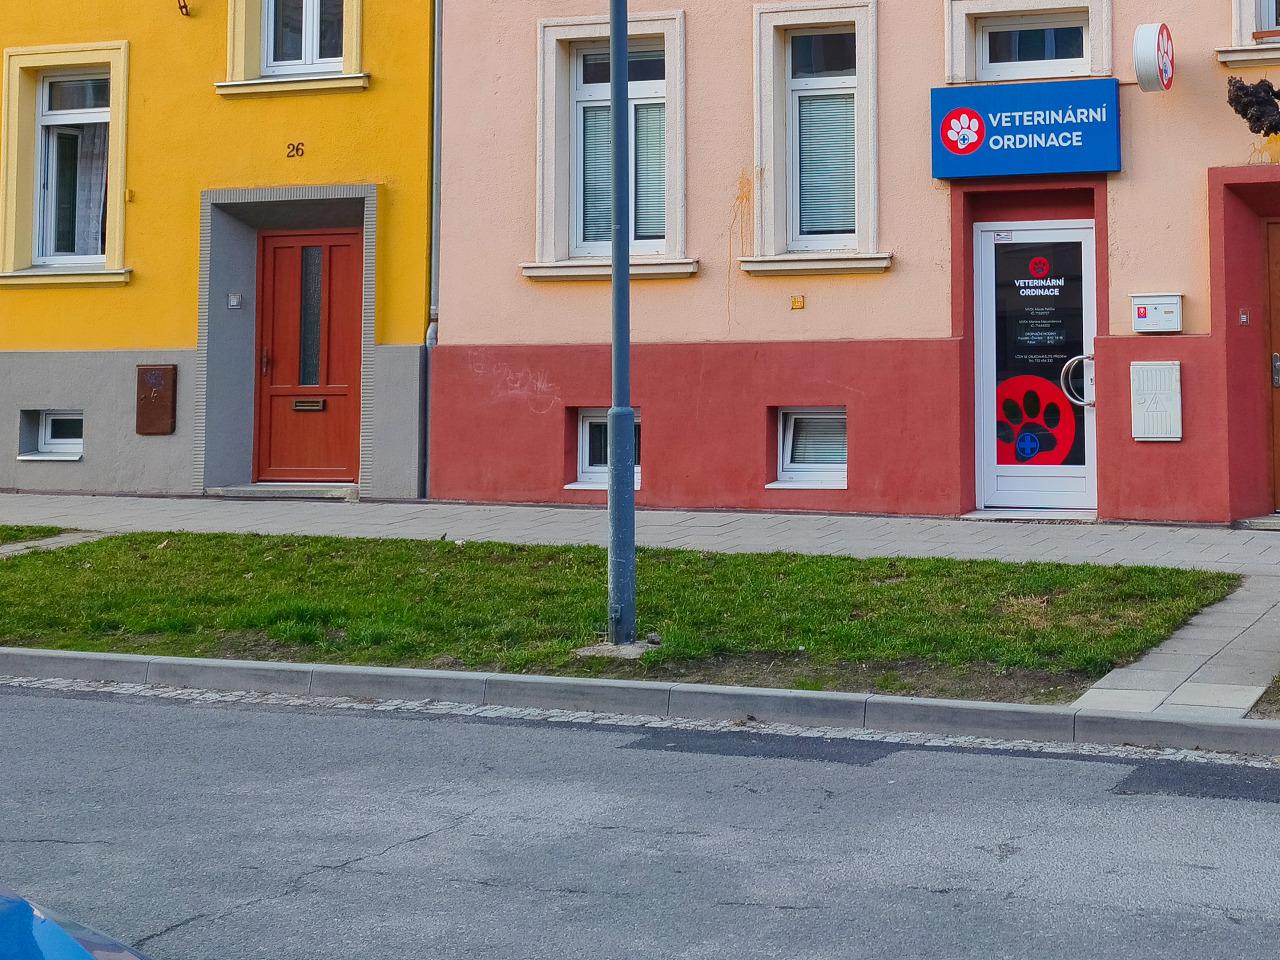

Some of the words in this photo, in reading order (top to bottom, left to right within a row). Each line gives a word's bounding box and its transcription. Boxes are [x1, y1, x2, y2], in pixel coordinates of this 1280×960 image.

[988, 104, 1107, 127] VETERINÁRNÍ
[989, 131, 1083, 150] ORDINACE
[286, 142, 305, 158] 26
[1014, 278, 1064, 287] VETERINÁRNÍ
[1019, 288, 1060, 296] ORDINACE
